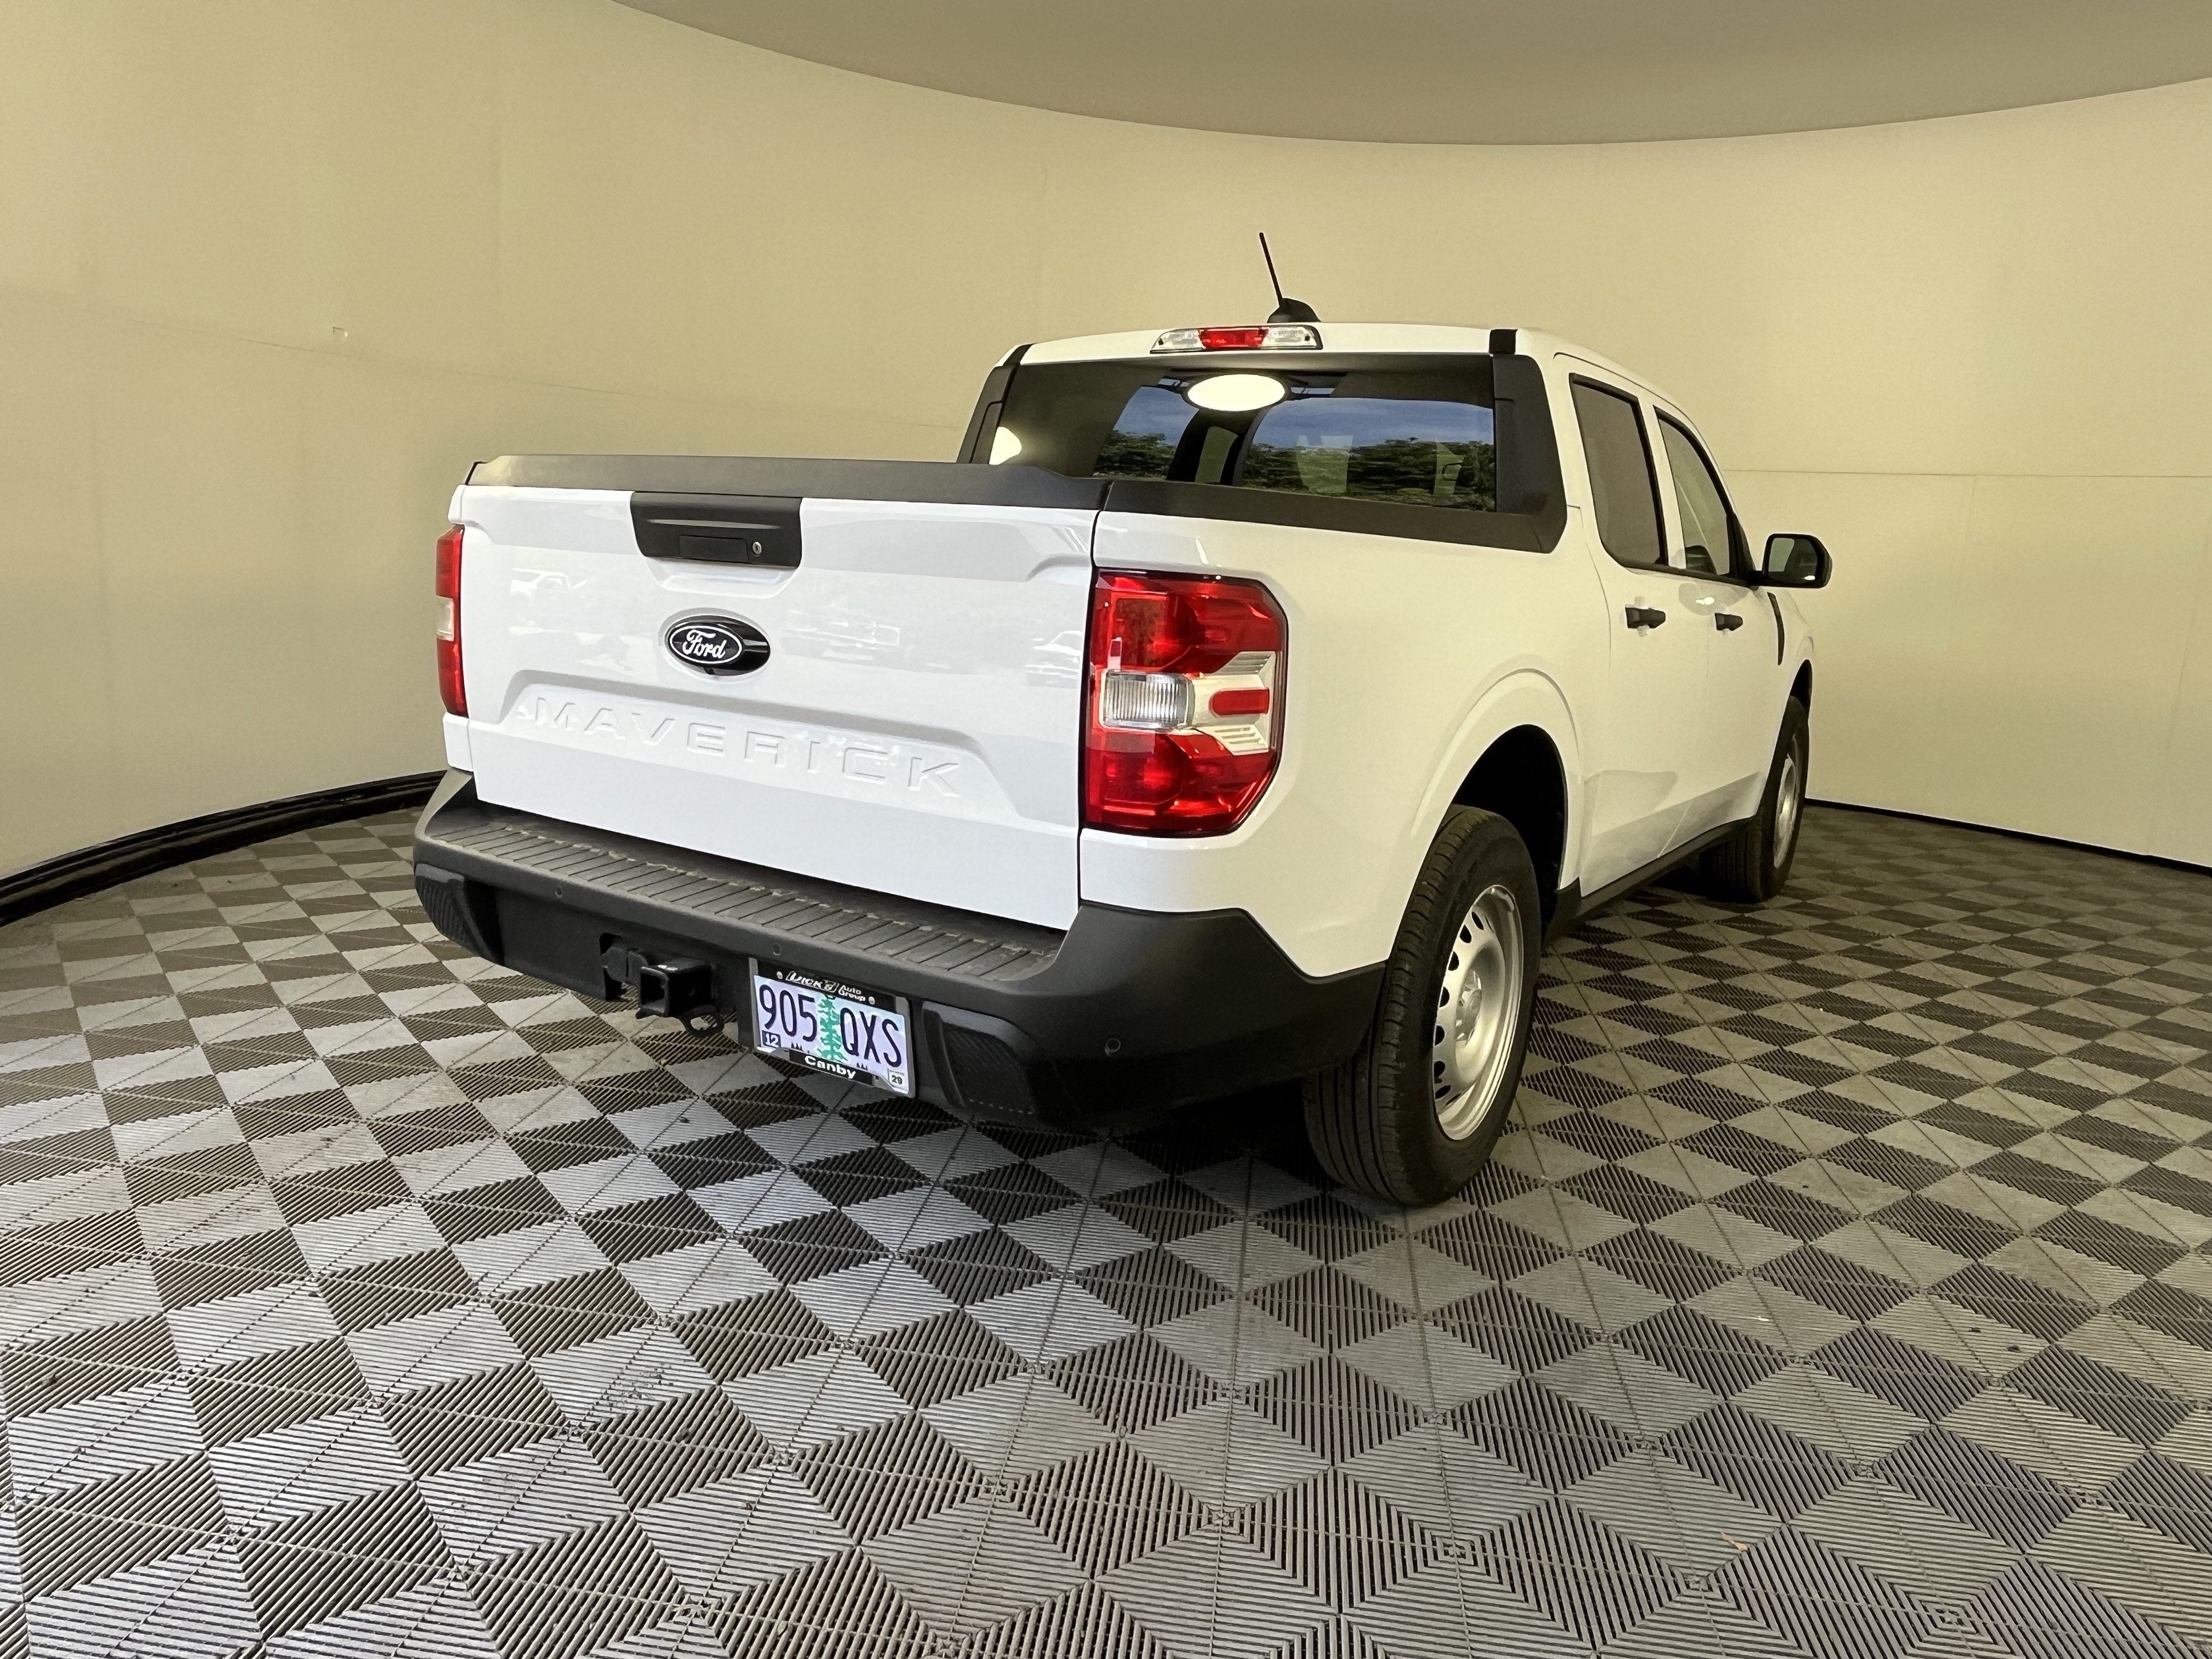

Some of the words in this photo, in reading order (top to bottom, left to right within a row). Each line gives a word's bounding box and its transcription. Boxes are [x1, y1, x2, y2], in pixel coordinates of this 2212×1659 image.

[682, 629, 727, 659] Ford
[533, 697, 958, 798] MAVERICK
[759, 984, 817, 1042] 905
[840, 1007, 902, 1068] QXS
[765, 1032, 779, 1048] 12
[804, 1055, 856, 1079] Canby
